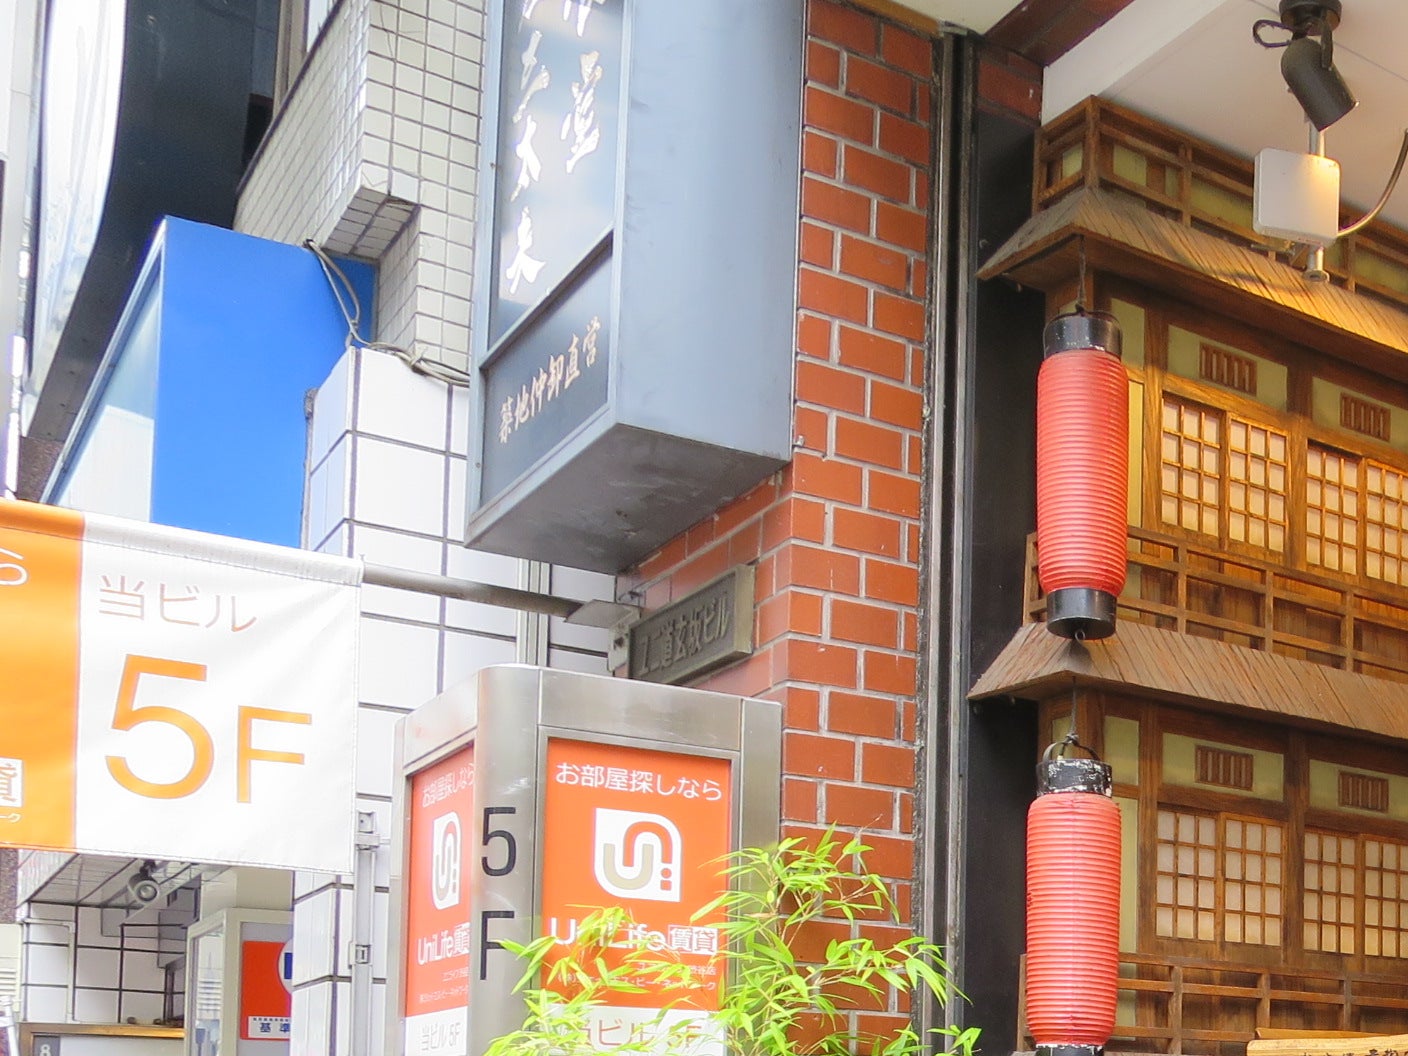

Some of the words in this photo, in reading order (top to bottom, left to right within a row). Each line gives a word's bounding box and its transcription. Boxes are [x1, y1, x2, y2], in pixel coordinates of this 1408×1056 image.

[98, 575, 257, 633] 当ビル
[105, 653, 313, 804] 5F
[422, 763, 474, 808] お部屋探しなら
[553, 762, 724, 803] お部屋探しなら
